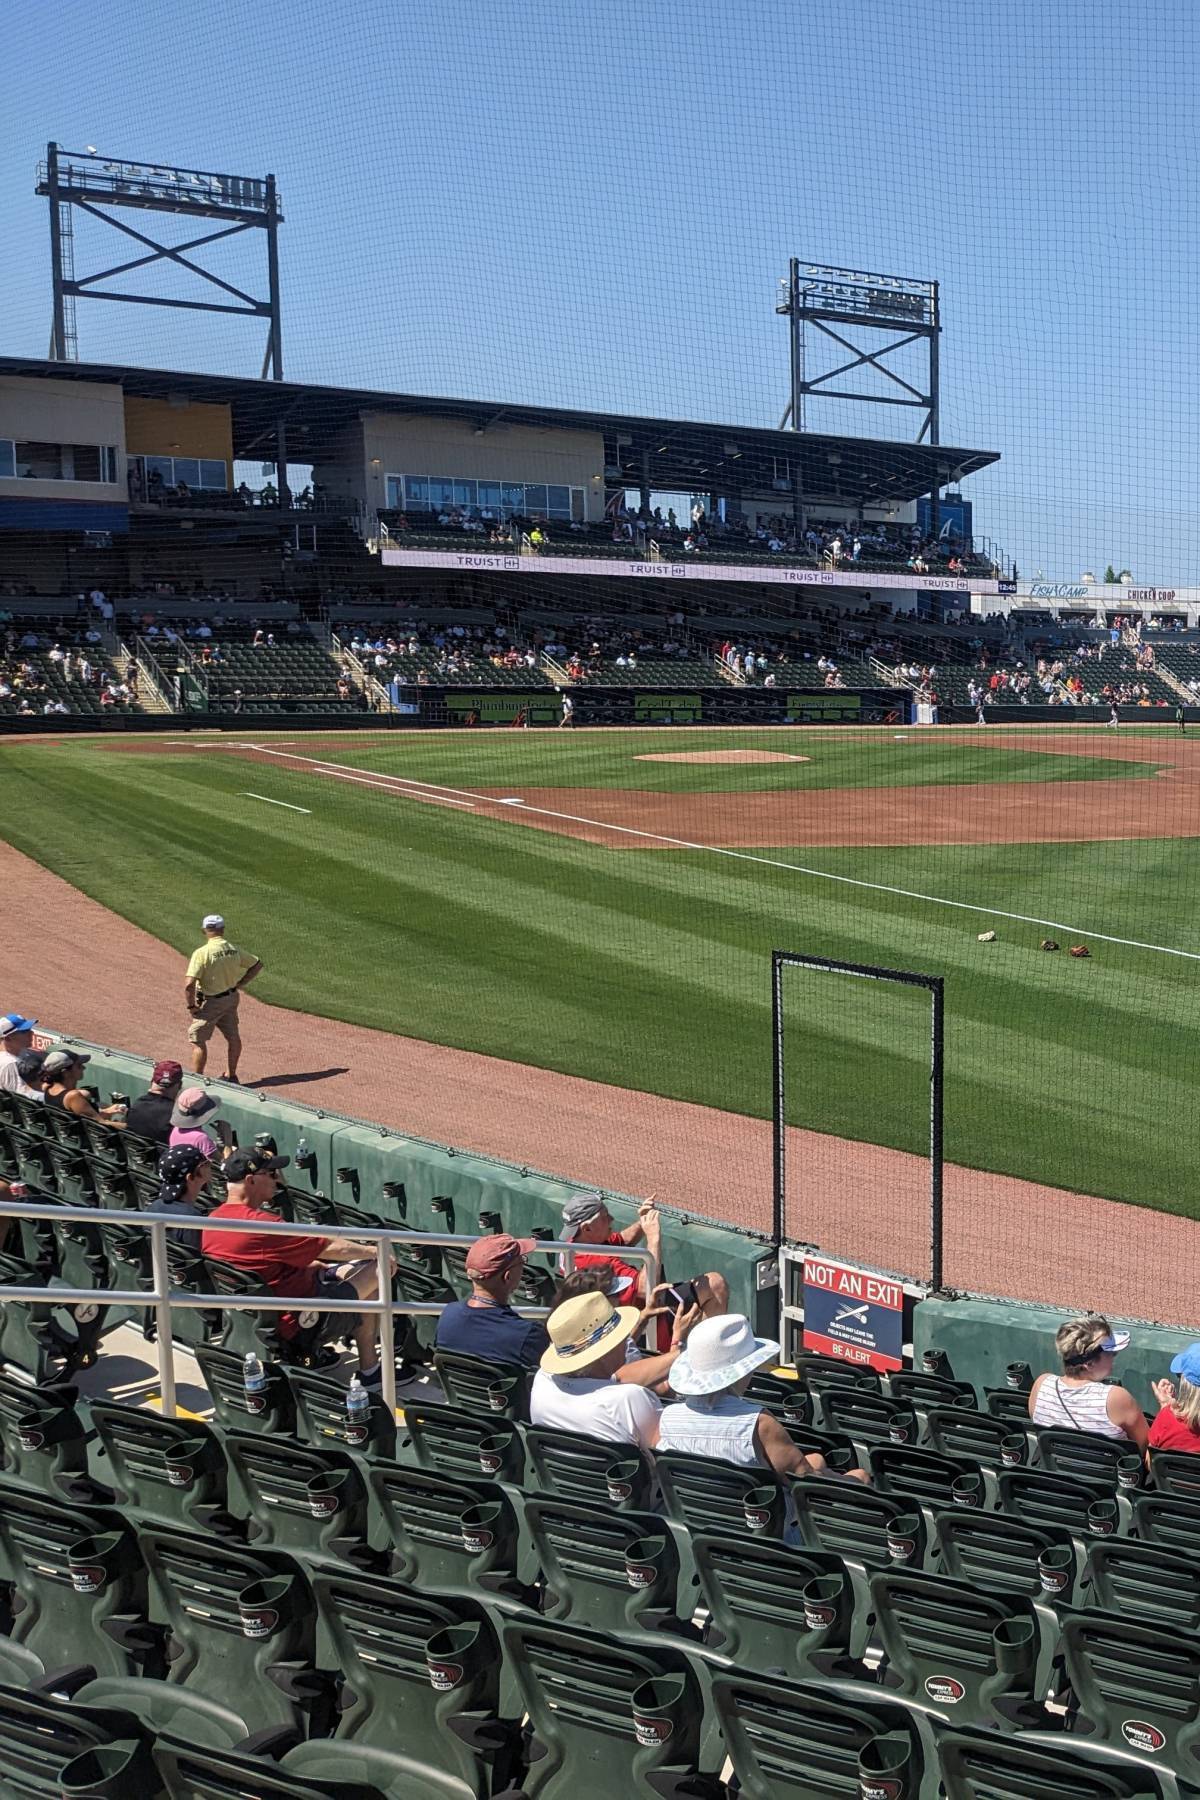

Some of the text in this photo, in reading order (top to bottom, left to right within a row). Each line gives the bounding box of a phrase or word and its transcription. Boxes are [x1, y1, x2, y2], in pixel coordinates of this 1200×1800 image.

[457, 556, 501, 567] TRUIST
[630, 564, 669, 575] TRUIST
[783, 572, 819, 582] TRUIST
[923, 579, 955, 588] TRUIST
[804, 1263, 900, 1307] NOT AN EXIT
[832, 1343, 871, 1365] BE ALERT
